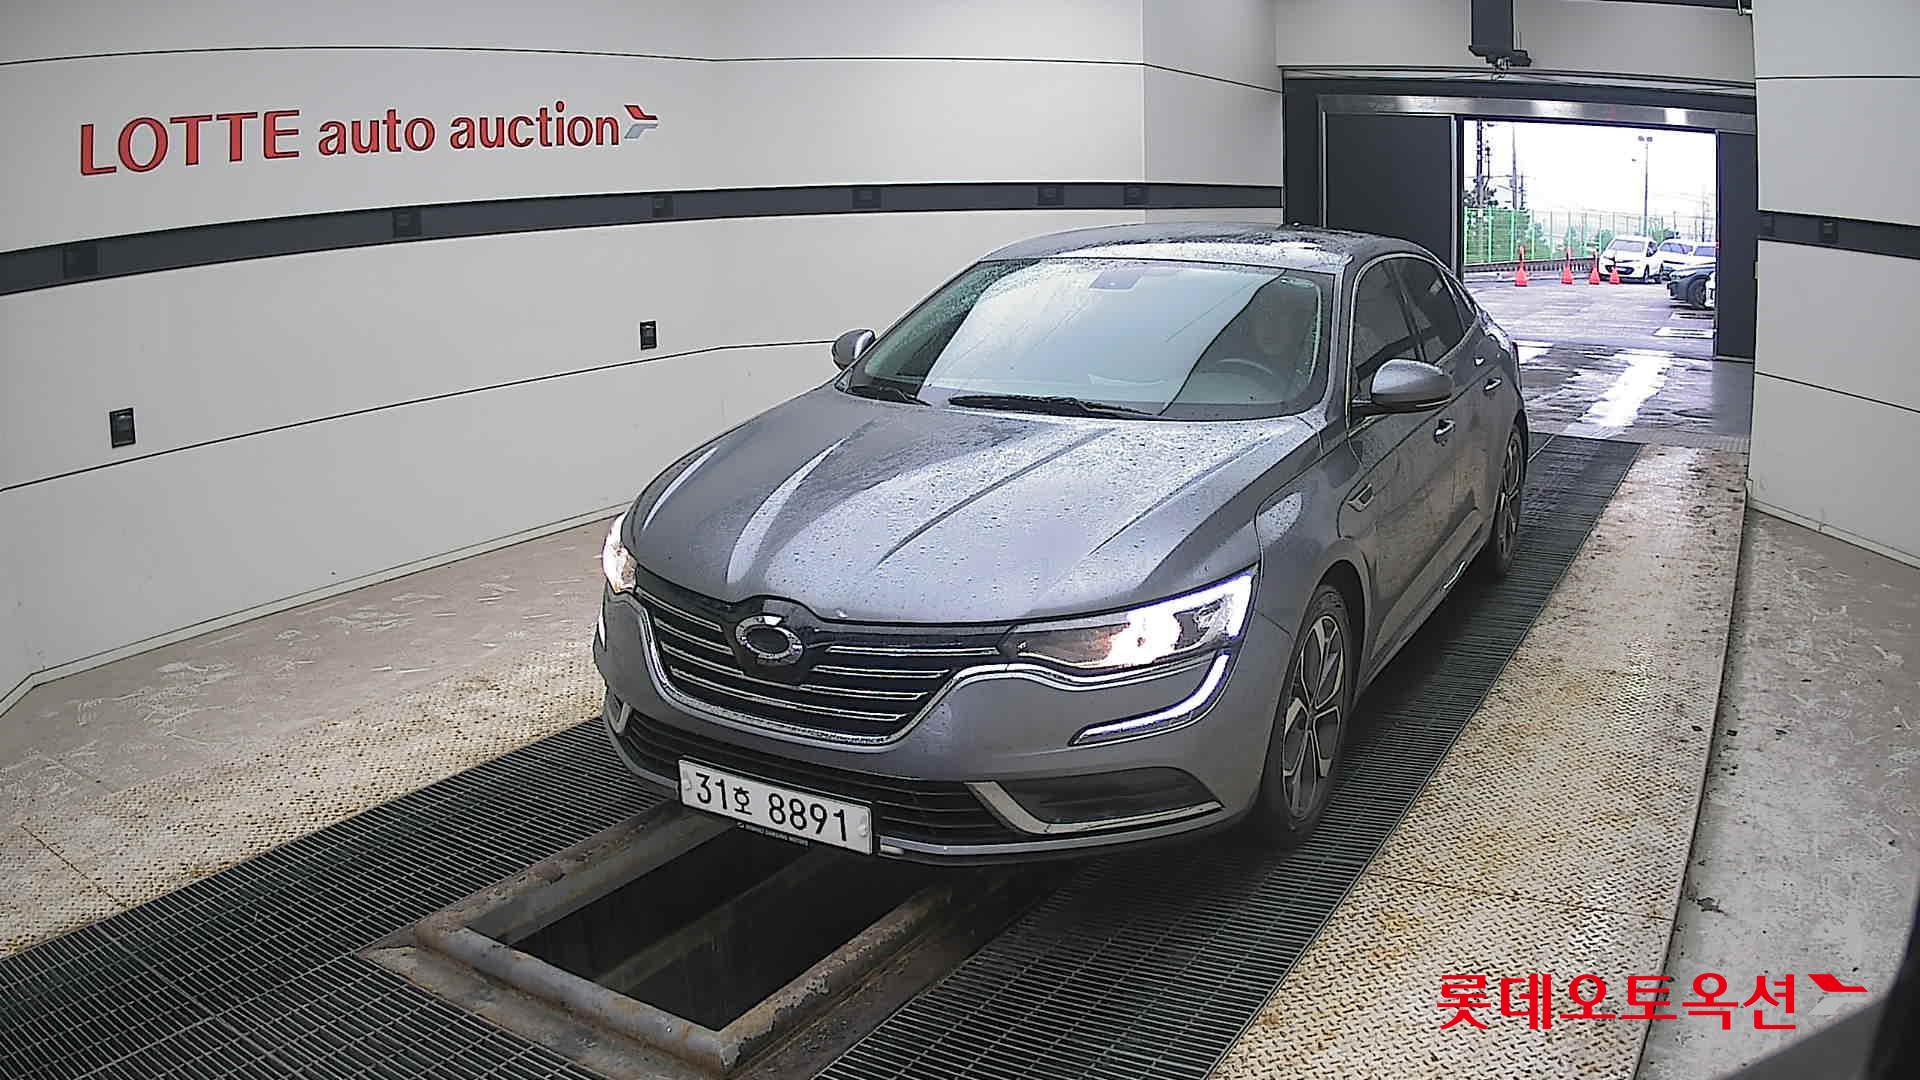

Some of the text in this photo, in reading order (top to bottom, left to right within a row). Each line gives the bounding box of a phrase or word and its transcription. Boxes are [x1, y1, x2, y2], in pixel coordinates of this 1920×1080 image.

[80, 100, 620, 176] LOTTE auto auction
[695, 772, 752, 815] 31호
[768, 793, 847, 841] 8891
